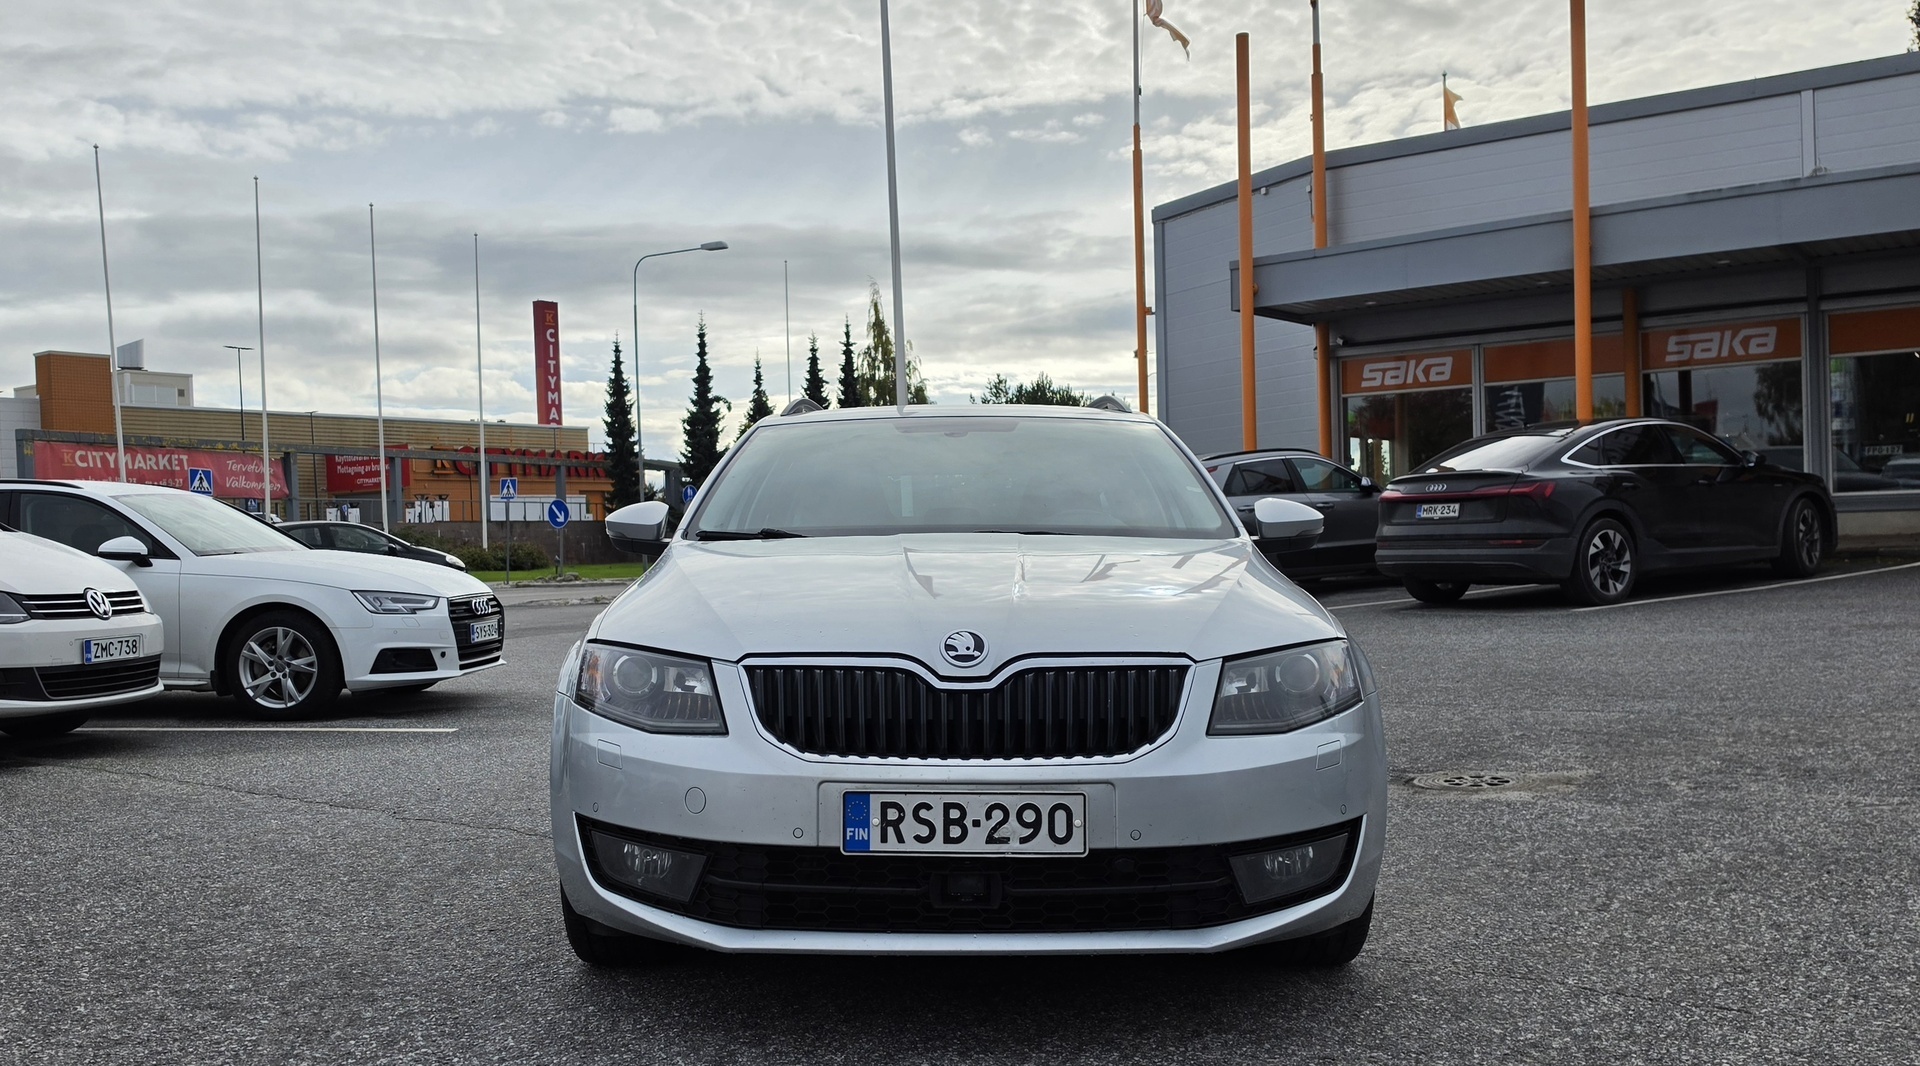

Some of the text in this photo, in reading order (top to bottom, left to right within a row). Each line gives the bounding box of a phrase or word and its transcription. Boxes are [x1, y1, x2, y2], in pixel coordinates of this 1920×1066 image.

[546, 329, 559, 426] CITYMA
[337, 463, 365, 475] Mottagning
[93, 639, 138, 659] ZMC-738
[846, 800, 1074, 845] FIN RSB-290
